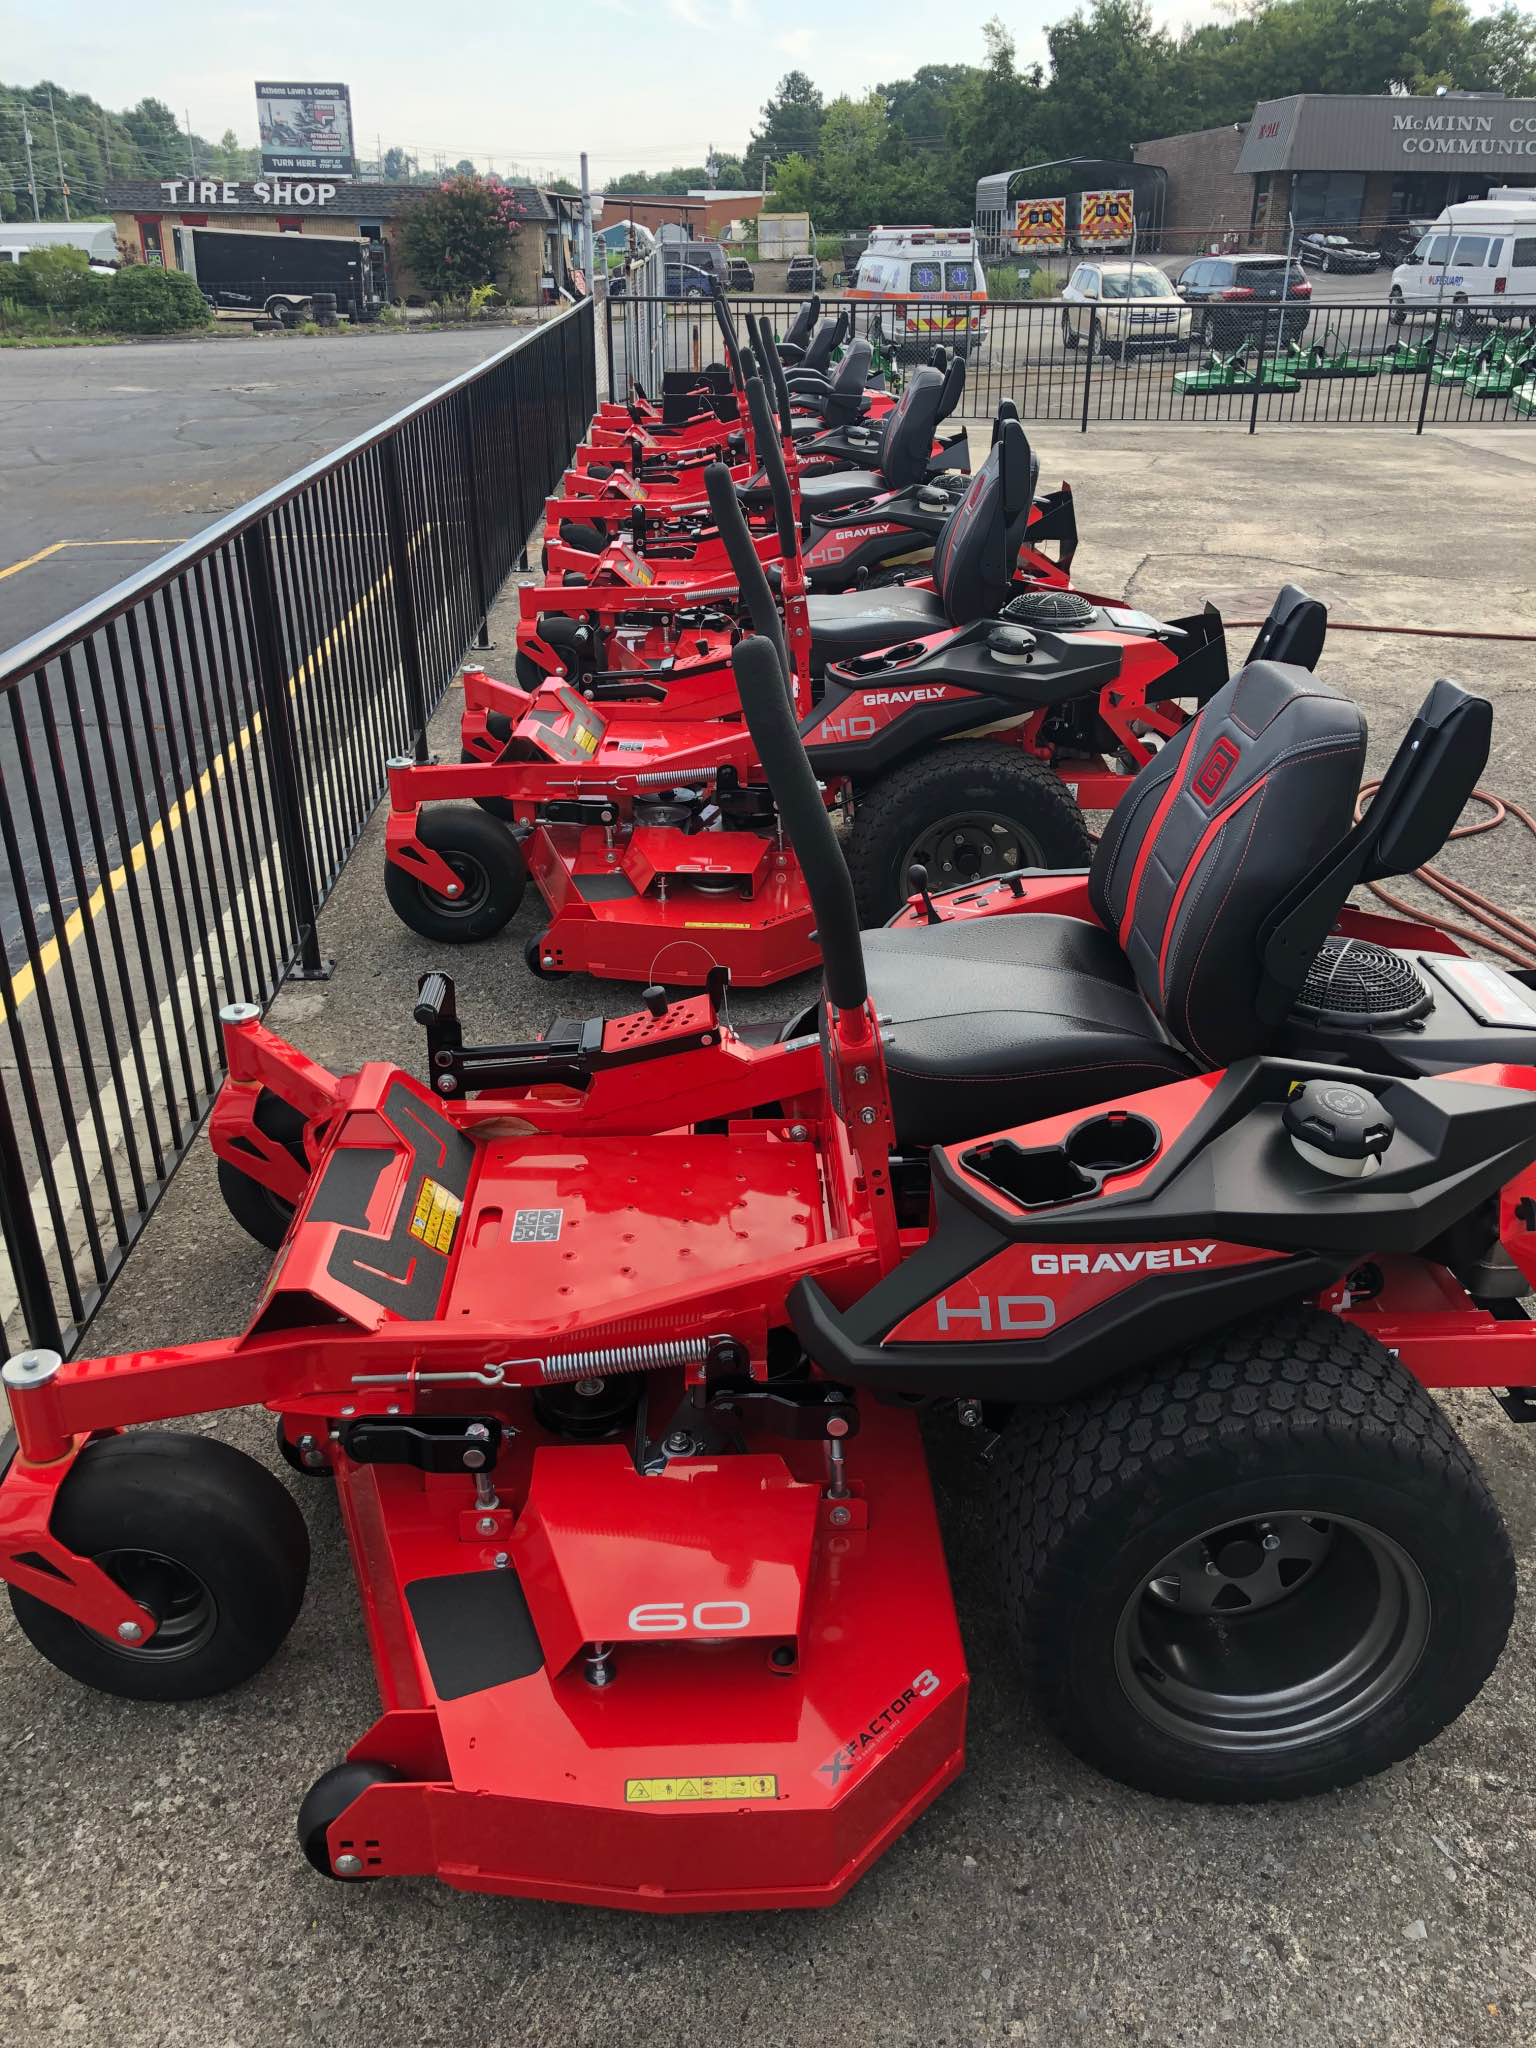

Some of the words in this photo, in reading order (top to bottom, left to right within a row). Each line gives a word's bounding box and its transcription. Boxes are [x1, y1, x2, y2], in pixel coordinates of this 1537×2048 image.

[261, 86, 286, 95] Athens
[287, 87, 306, 95] Lawn
[307, 87, 313, 95] &
[313, 87, 339, 96] Garden
[1392, 115, 1494, 131] McMINN
[271, 158, 294, 167] TURN
[296, 159, 317, 168] HERE
[160, 181, 240, 204] TIRE
[253, 181, 336, 206] SHOP
[835, 524, 890, 540] GRAVELY
[808, 546, 845, 563] HD
[863, 686, 947, 706] GRAVELY
[821, 716, 876, 739] HD
[675, 864, 732, 872] 60
[1031, 1244, 1217, 1275] GRAVELY
[936, 1295, 1056, 1331] HD
[628, 1601, 751, 1632] 60
